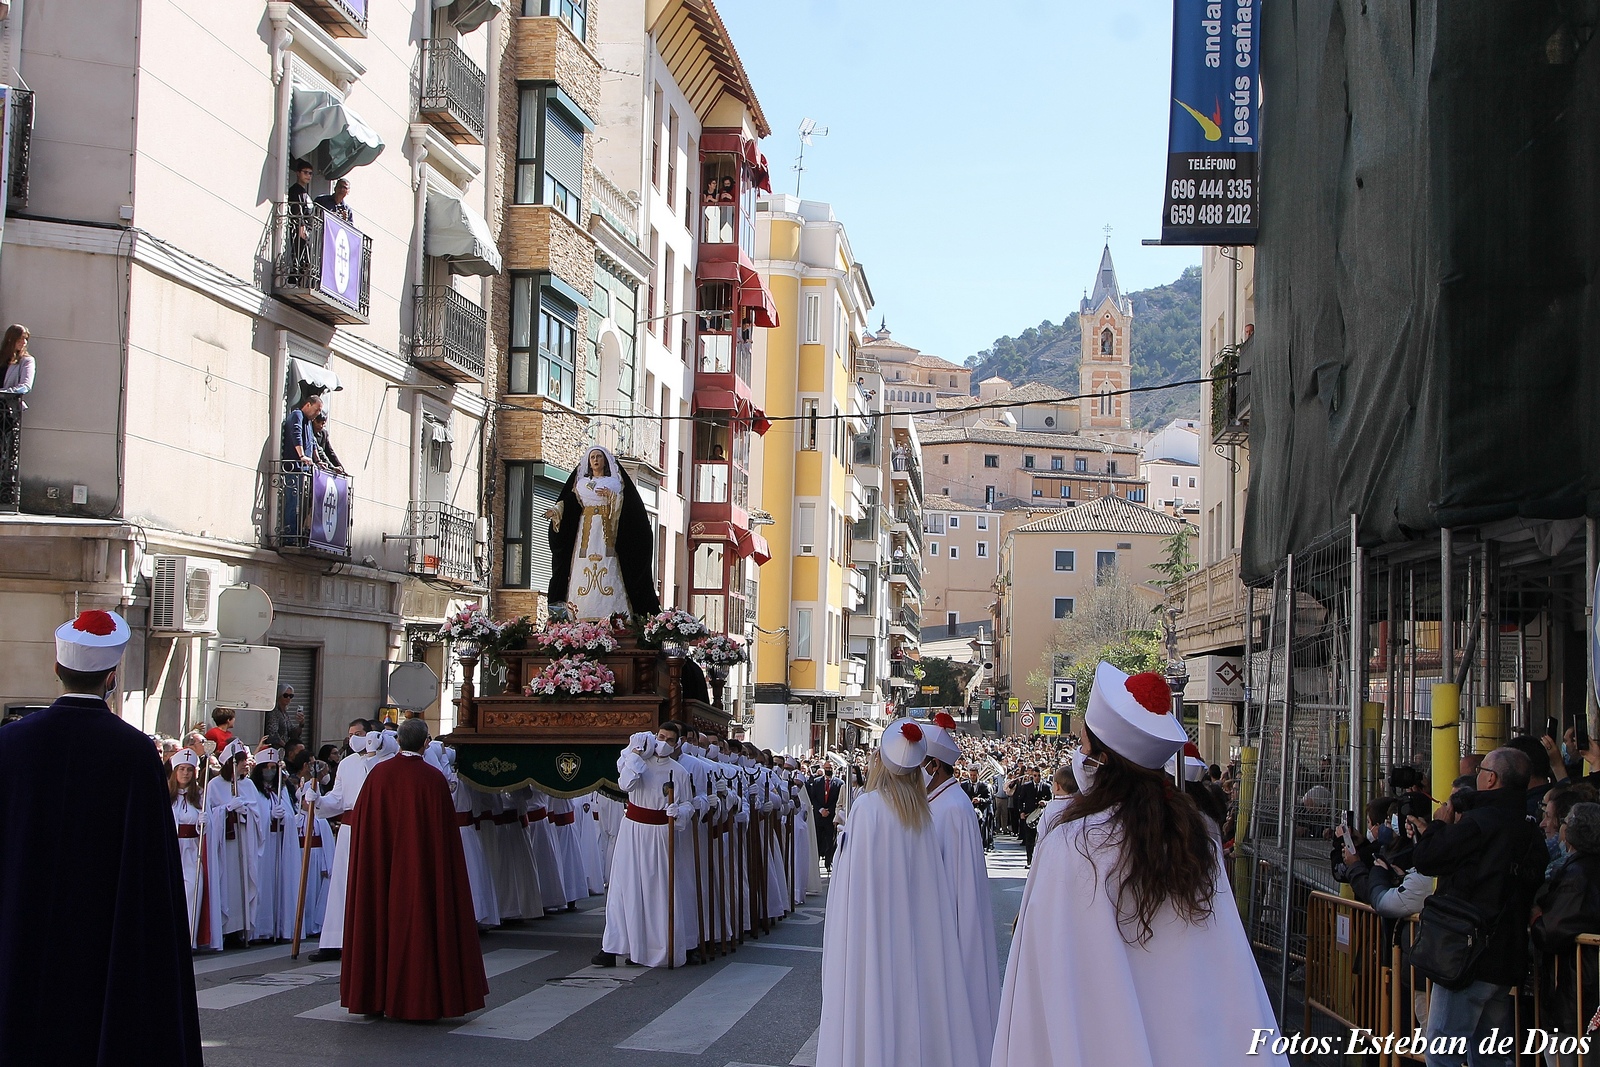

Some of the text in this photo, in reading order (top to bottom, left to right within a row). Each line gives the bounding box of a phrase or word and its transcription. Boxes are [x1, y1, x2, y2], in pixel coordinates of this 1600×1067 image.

[1229, 76, 1253, 145] jesús
[1188, 156, 1236, 170] TELÉFONO
[1171, 179, 1251, 199] 696 444 335
[1170, 204, 1251, 225] 659 488 202
[1055, 683, 1074, 703] P
